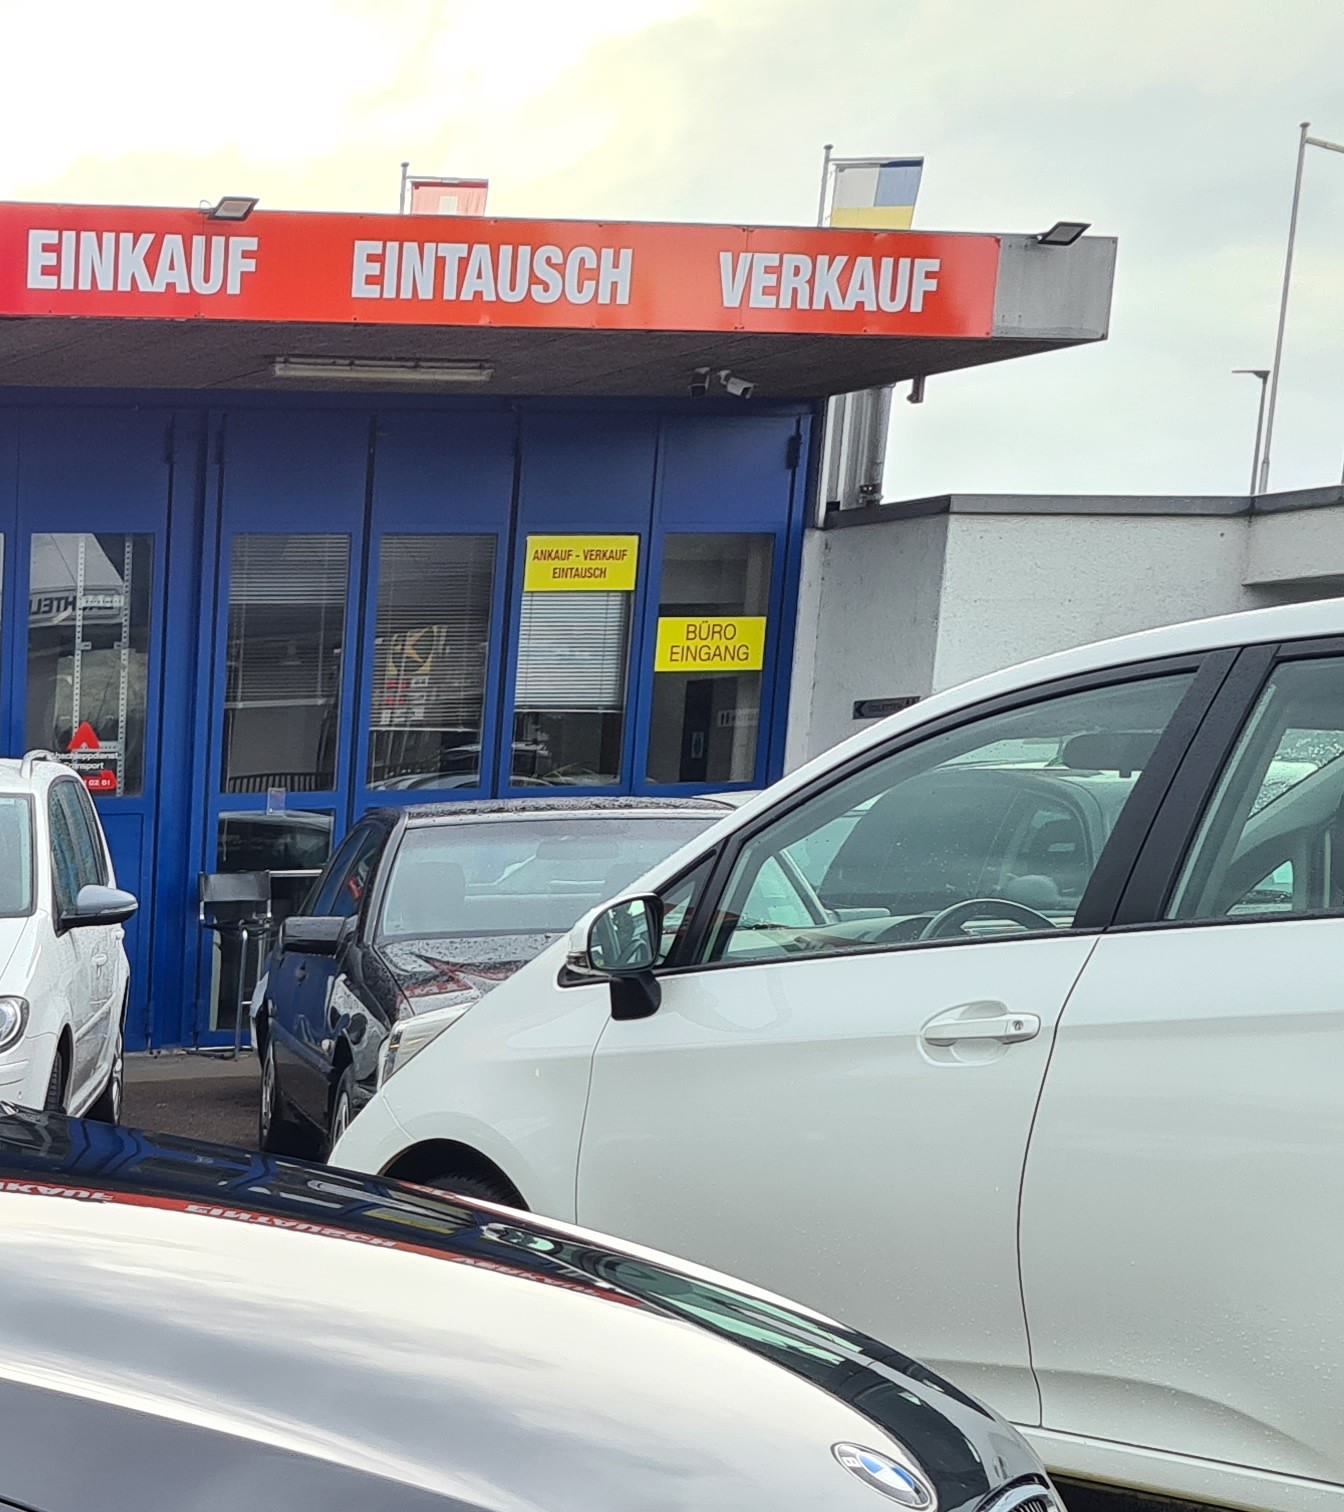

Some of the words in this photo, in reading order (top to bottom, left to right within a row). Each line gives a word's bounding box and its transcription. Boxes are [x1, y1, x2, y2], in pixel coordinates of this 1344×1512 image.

[27, 229, 259, 295] EINKAUF
[351, 240, 633, 305] EINTAUSCH
[719, 251, 941, 313] VERKAUF
[532, 549, 573, 561] ANKAUF
[583, 549, 628, 561] VERKAUF
[552, 567, 607, 579] EINTAUSCH
[685, 620, 737, 641] BÜRO
[669, 644, 750, 662] EINGANG
